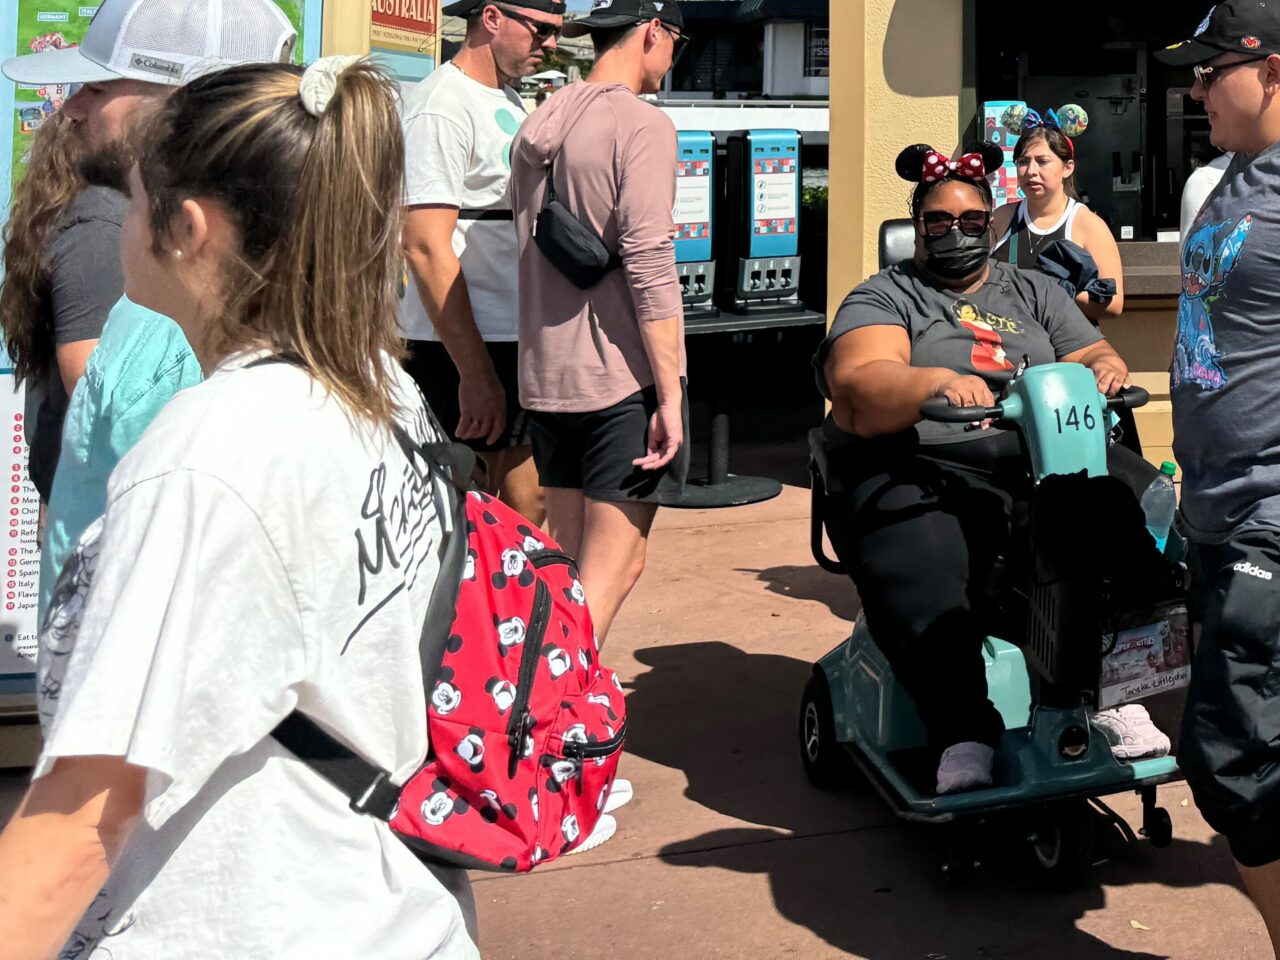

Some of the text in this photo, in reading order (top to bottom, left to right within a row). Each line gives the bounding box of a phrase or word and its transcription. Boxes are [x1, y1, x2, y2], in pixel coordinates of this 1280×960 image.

[143, 59, 179, 74] Columbia
[1054, 404, 1096, 434] 146
[20, 547, 34, 555] The
[19, 569, 39, 578] Spain
[1233, 561, 1273, 580] adidas
[18, 580, 35, 589] Italy
[17, 633, 30, 641] Eat
